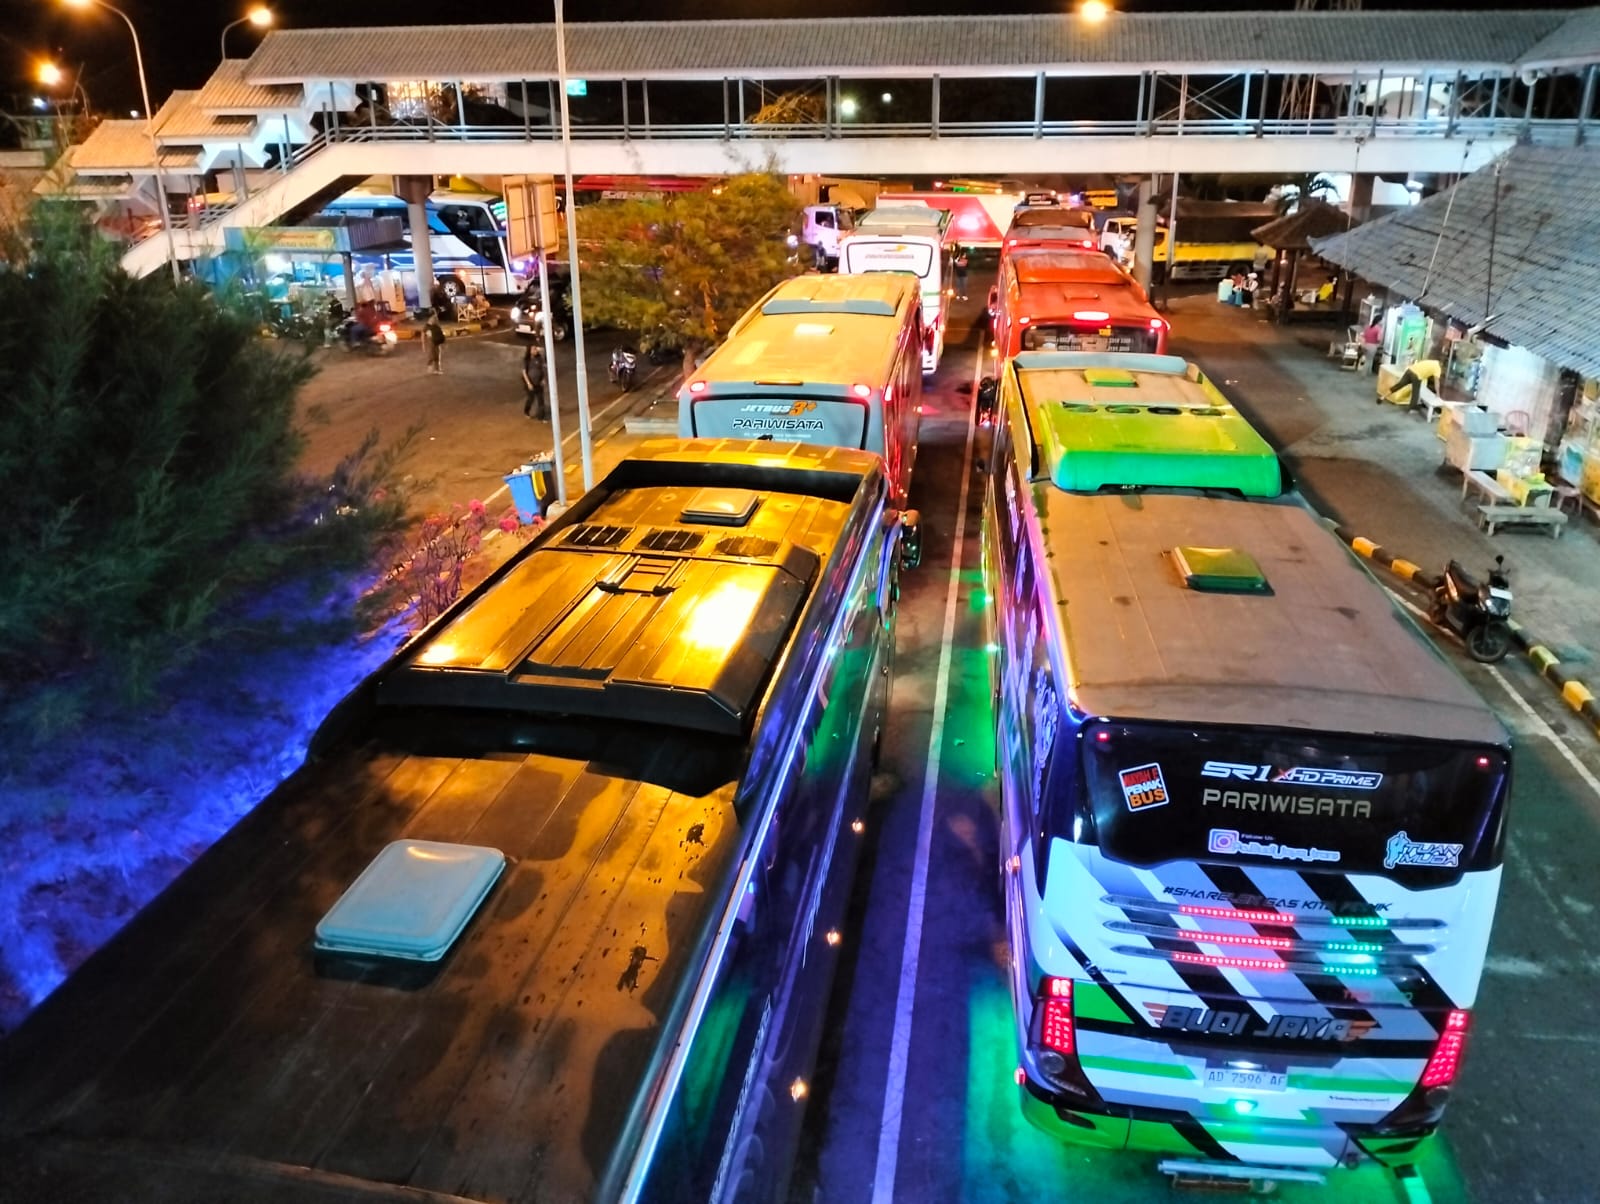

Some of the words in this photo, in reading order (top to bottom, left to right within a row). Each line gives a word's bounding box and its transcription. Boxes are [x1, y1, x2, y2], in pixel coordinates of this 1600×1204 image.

[732, 419, 824, 430] PARIWISATA
[1320, 772, 1376, 786] PRIME
[1129, 788, 1166, 807] BUS
[1202, 788, 1372, 818] PARIWISATA
[1405, 843, 1462, 855] TUAN
[1265, 897, 1300, 909] GAS
[1160, 1004, 1249, 1036] BUDI
[1253, 1014, 1354, 1041] JAYA
[1208, 1071, 1224, 1082] AD
[1231, 1072, 1262, 1084] 7596
